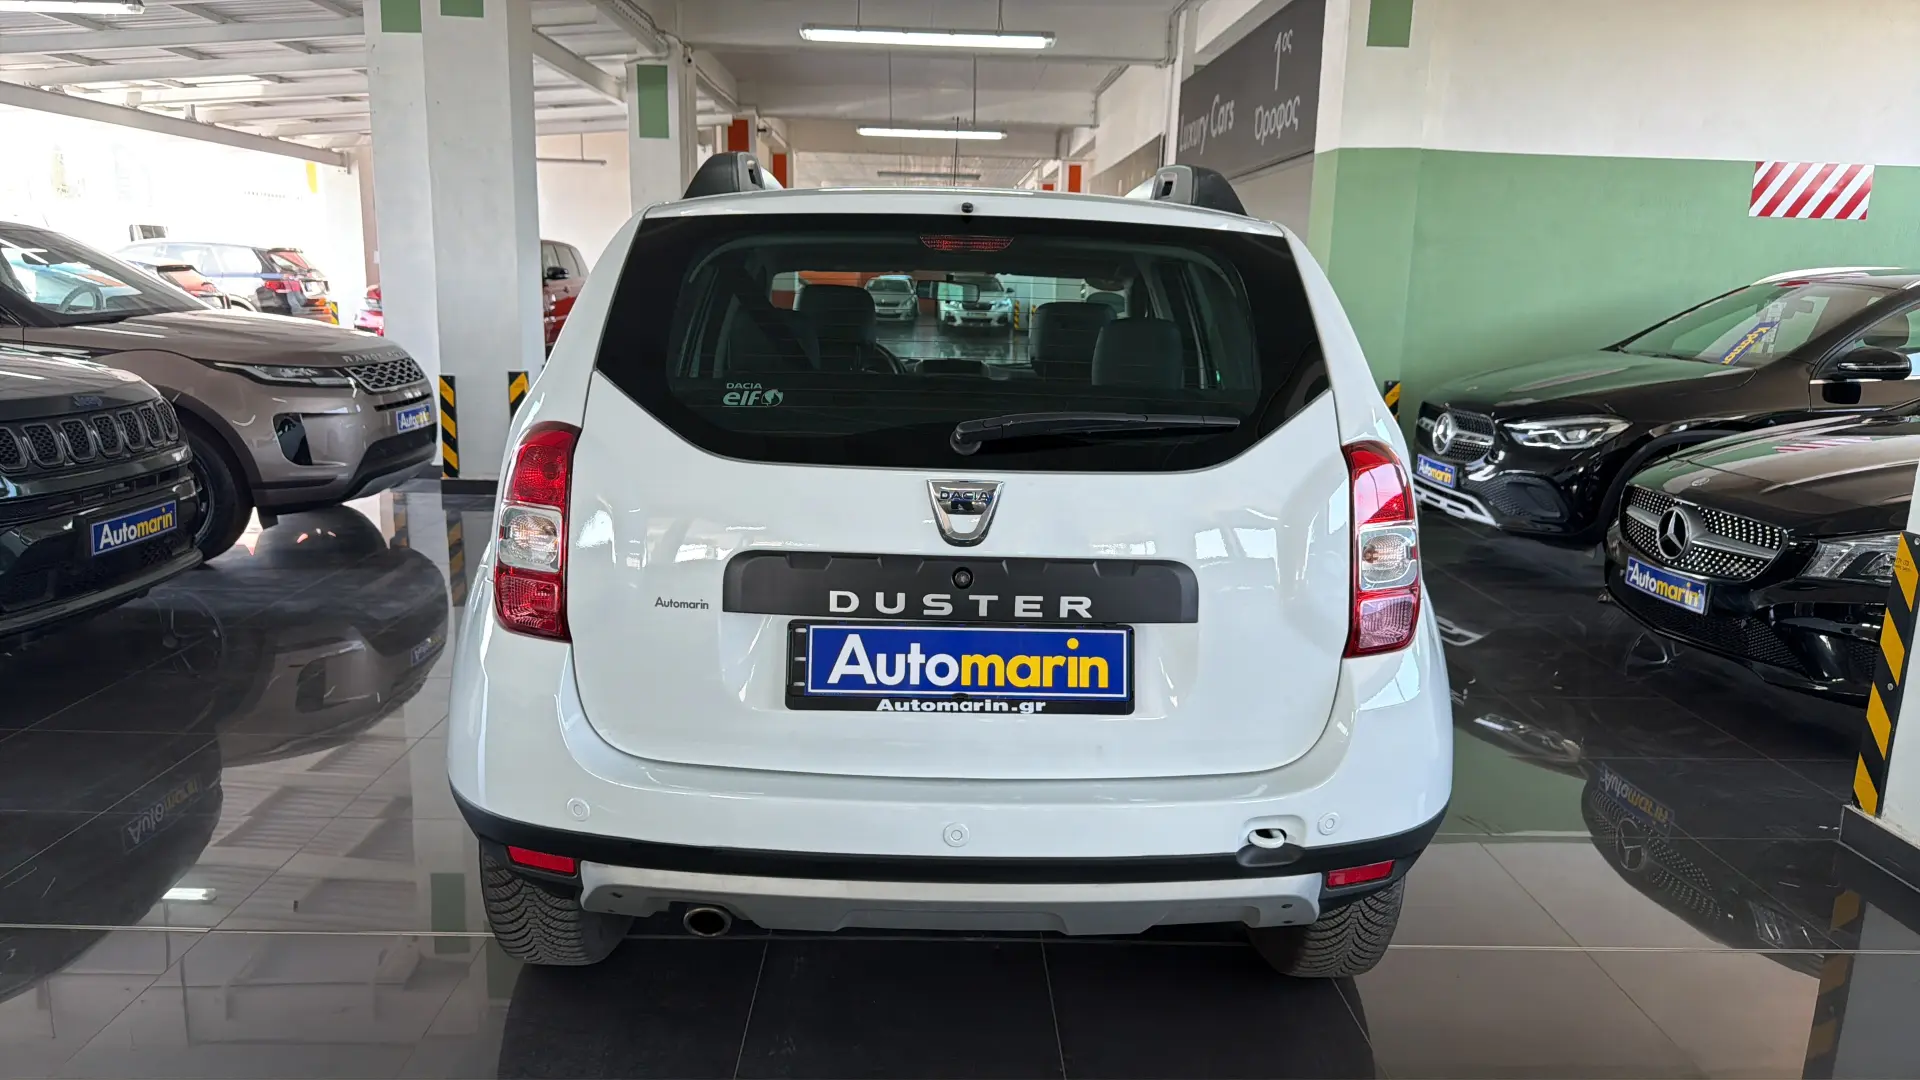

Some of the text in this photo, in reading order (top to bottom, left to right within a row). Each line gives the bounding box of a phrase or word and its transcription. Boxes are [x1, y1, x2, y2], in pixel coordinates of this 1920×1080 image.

[1179, 93, 1235, 156] Luxury Cars
[726, 382, 763, 390] DACIA
[722, 390, 762, 406] elf
[940, 490, 989, 500] DACIA
[99, 507, 173, 550] Automarin
[1630, 562, 1700, 608] Automarin
[654, 596, 709, 610] Automarin
[828, 590, 1093, 618] DUSTER
[827, 633, 1109, 688] Automarin
[876, 697, 1047, 714] Automarin.gr
